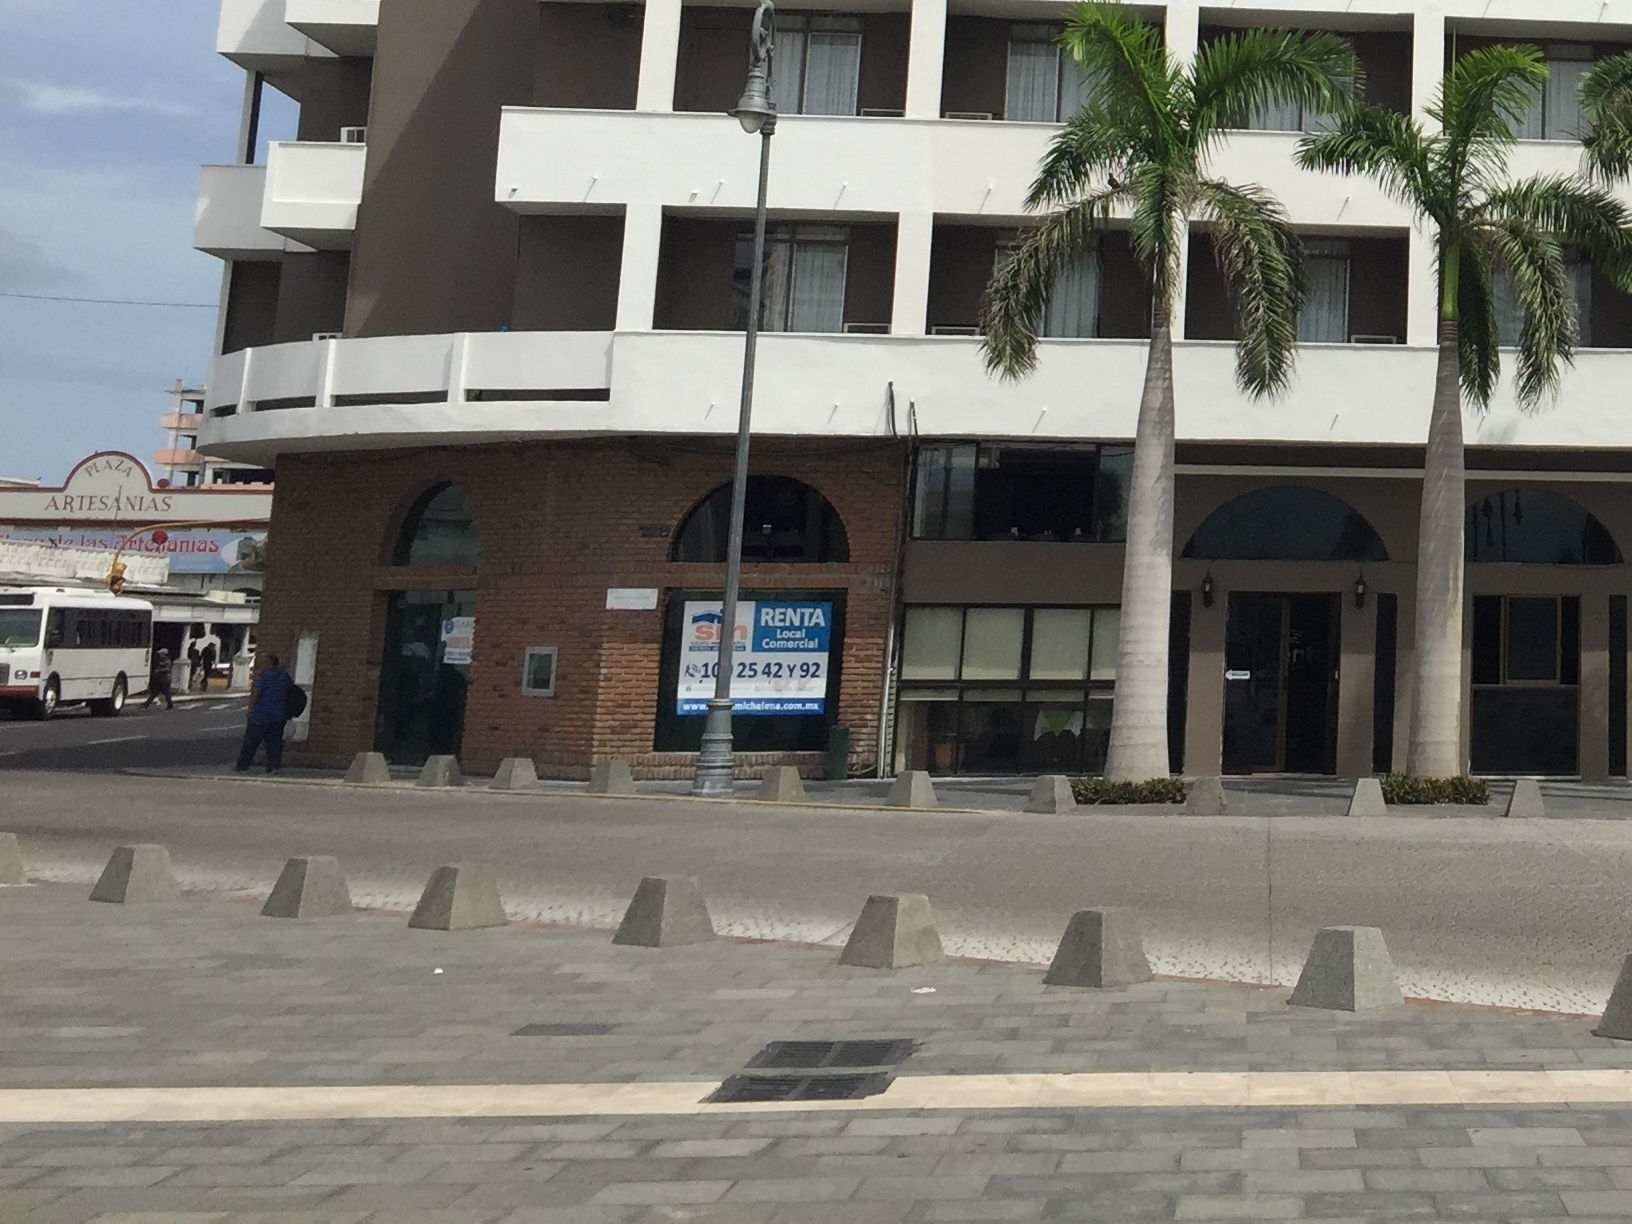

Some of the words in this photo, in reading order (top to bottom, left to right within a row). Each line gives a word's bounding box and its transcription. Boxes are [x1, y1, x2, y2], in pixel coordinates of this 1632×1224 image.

[85, 459, 132, 477] PLAZA
[44, 495, 173, 512] ARTESANIAS
[760, 608, 825, 627] RENTA
[776, 628, 805, 639] Local
[762, 638, 818, 649] Comercial
[701, 662, 733, 678] 10
[736, 662, 757, 678] 25
[762, 662, 783, 678] 42
[787, 664, 797, 678] Y
[799, 662, 821, 678] 92
